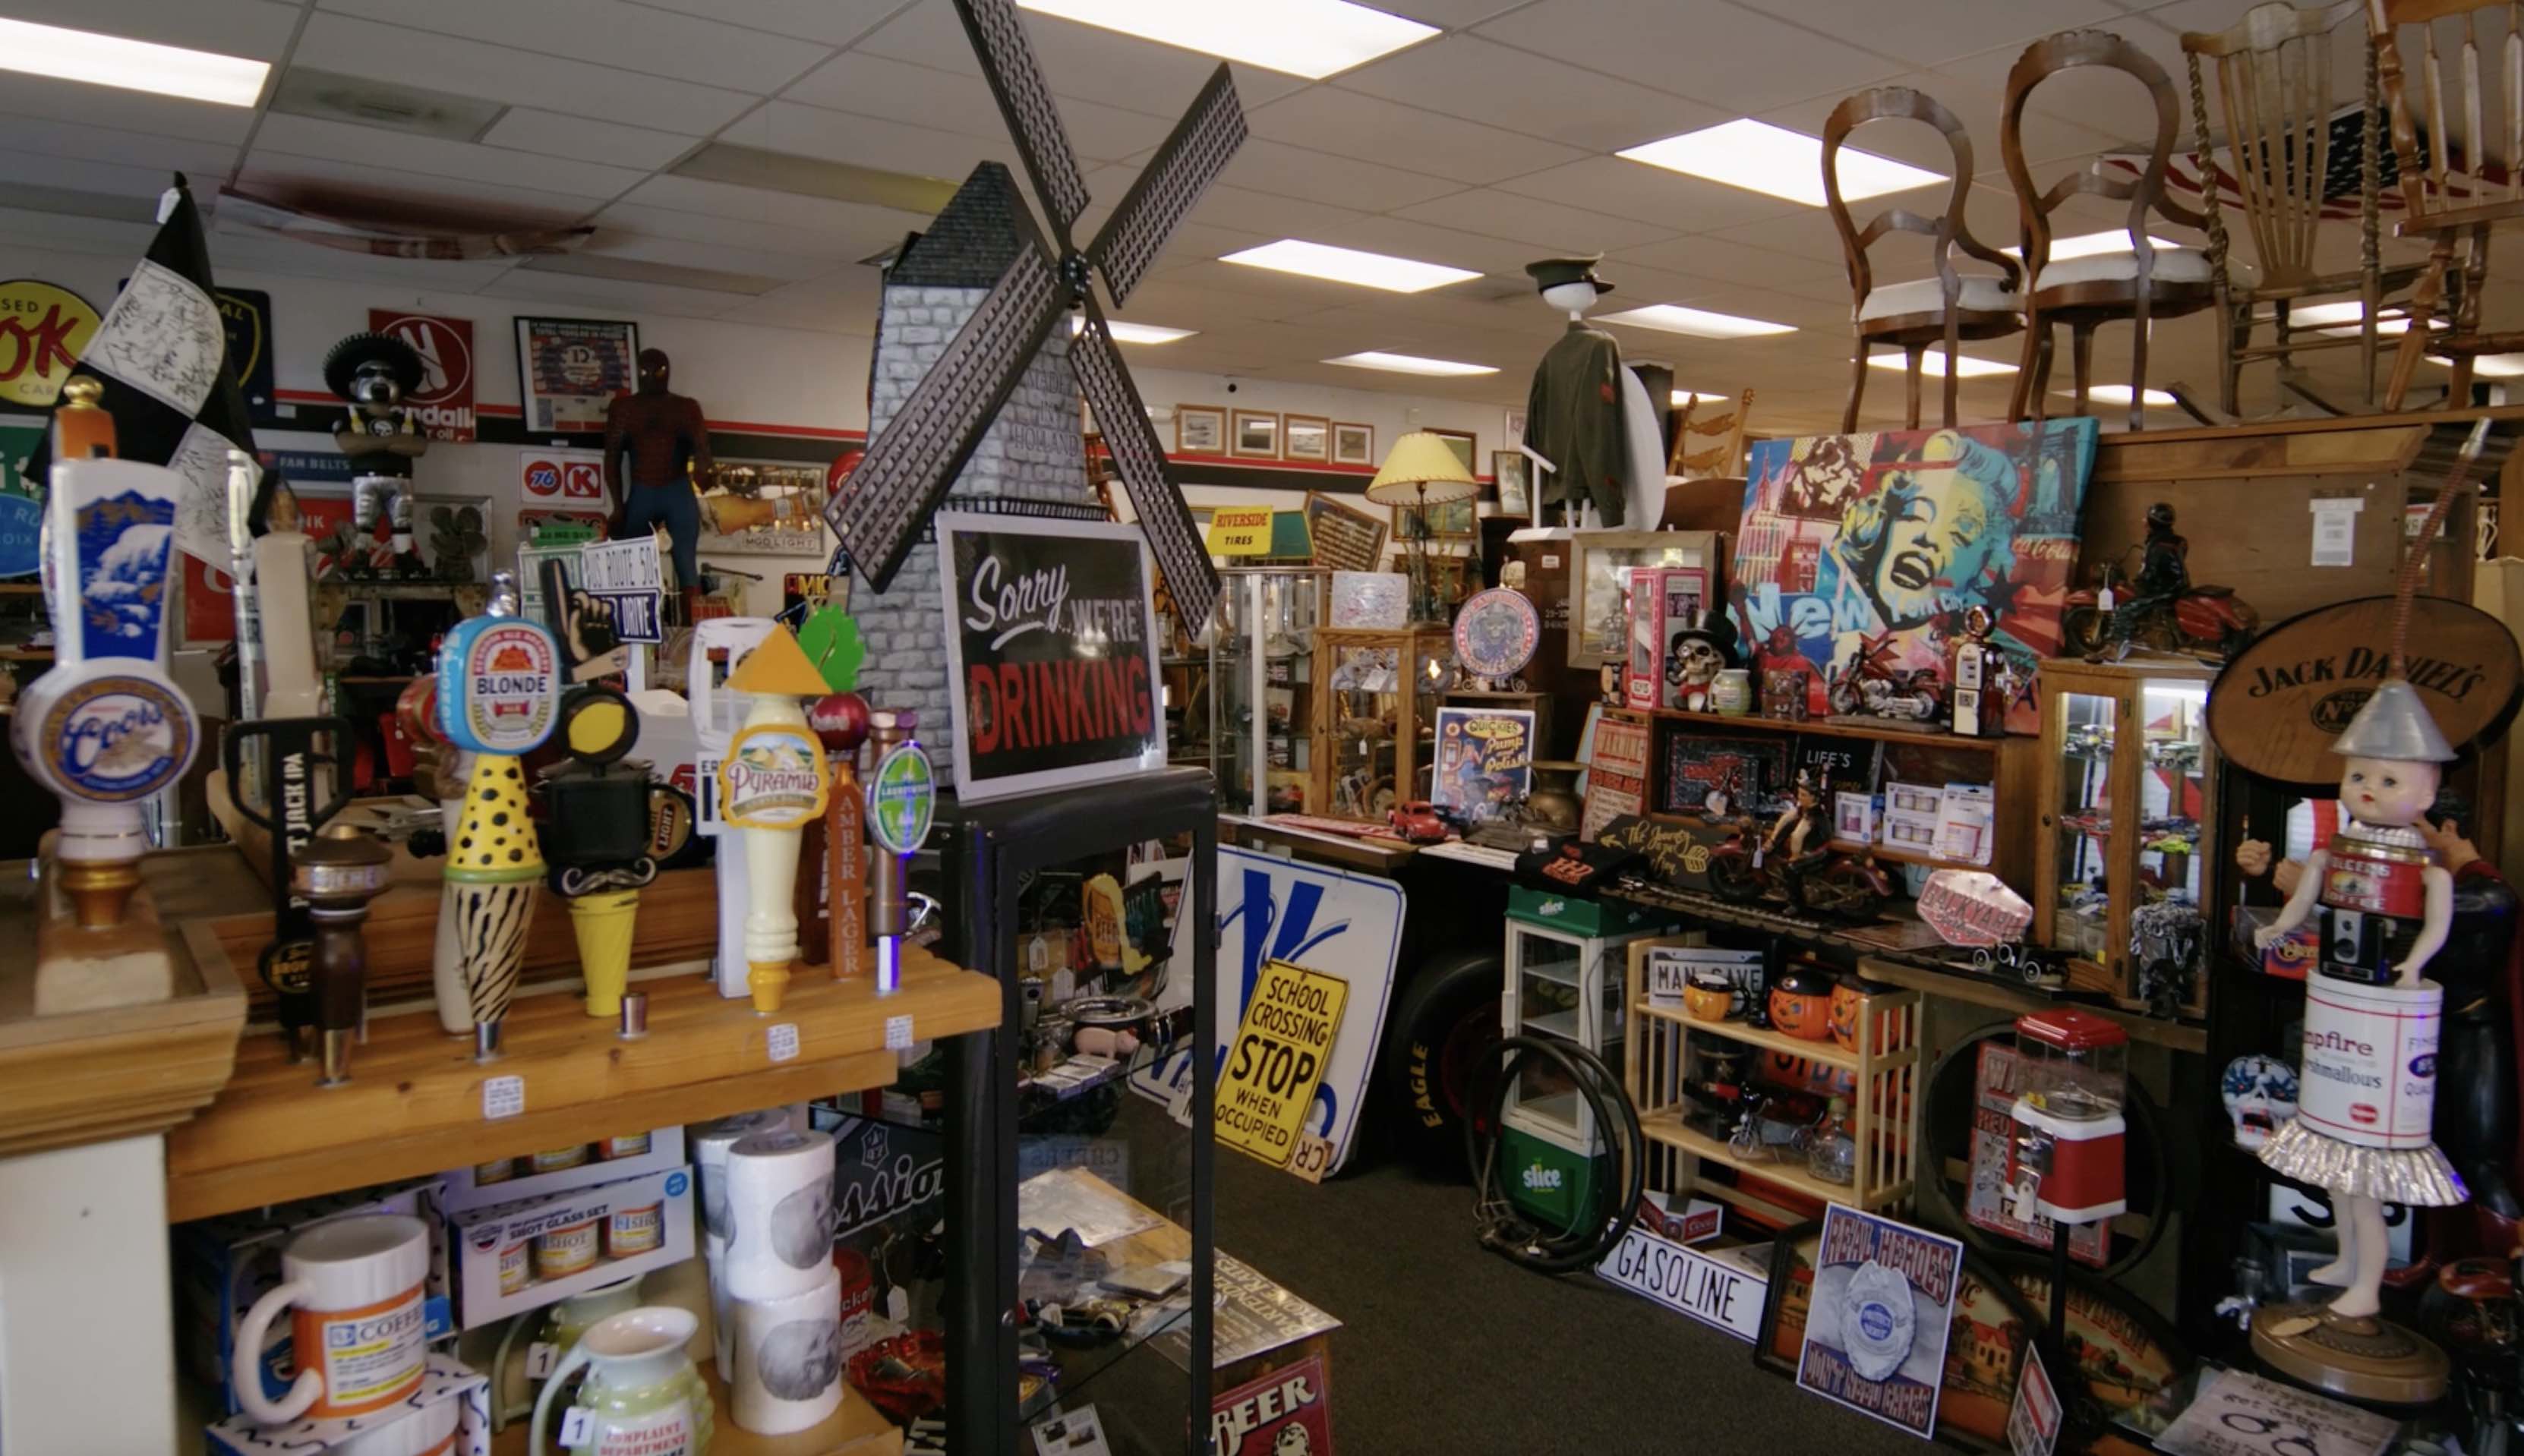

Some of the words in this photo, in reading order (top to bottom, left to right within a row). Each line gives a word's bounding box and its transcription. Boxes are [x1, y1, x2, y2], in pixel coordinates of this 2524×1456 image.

[2, 298, 39, 313] SED
[279, 456, 304, 468] FAN
[533, 471, 556, 487] 76
[1216, 512, 1268, 529] RIVERSIDE
[1225, 535, 1253, 546] TIRES
[774, 538, 814, 550] LIGHT
[965, 555, 1070, 633] Sorry
[1070, 598, 1140, 642] WE'RE
[477, 676, 547, 695] BLONDE
[2248, 655, 2336, 698] JACK
[970, 655, 1153, 755] DRINKING
[64, 701, 162, 774] Coors
[282, 752, 303, 780] IPA
[1806, 749, 1851, 768] LIFE'S
[727, 761, 820, 800] PYRAMID
[286, 780, 313, 834] JACK
[658, 807, 674, 848] LIGHT
[838, 796, 857, 881] AMBER
[841, 888, 860, 974] LAGER
[1267, 975, 1330, 1016] SCHOOL
[1251, 1001, 1330, 1047] CROSSING
[1232, 1033, 1316, 1100] STOP
[1409, 1041, 1443, 1128] EAGLE
[1235, 1086, 1283, 1120] WHEN
[1215, 1104, 1289, 1147] OCCUPIED
[1522, 1164, 1562, 1189] slice
[510, 1224, 544, 1240] SHOT
[547, 1212, 584, 1230] GLASS
[586, 1204, 609, 1218] SET
[1617, 1234, 1741, 1324] GASOLINE
[1823, 1215, 1874, 1265] REAL
[1877, 1228, 1955, 1308] HEROES
[538, 1352, 548, 1372] 1
[1213, 1375, 1317, 1439] BEER
[574, 1417, 584, 1440] 1
[605, 1420, 681, 1442] COMPLAINT
